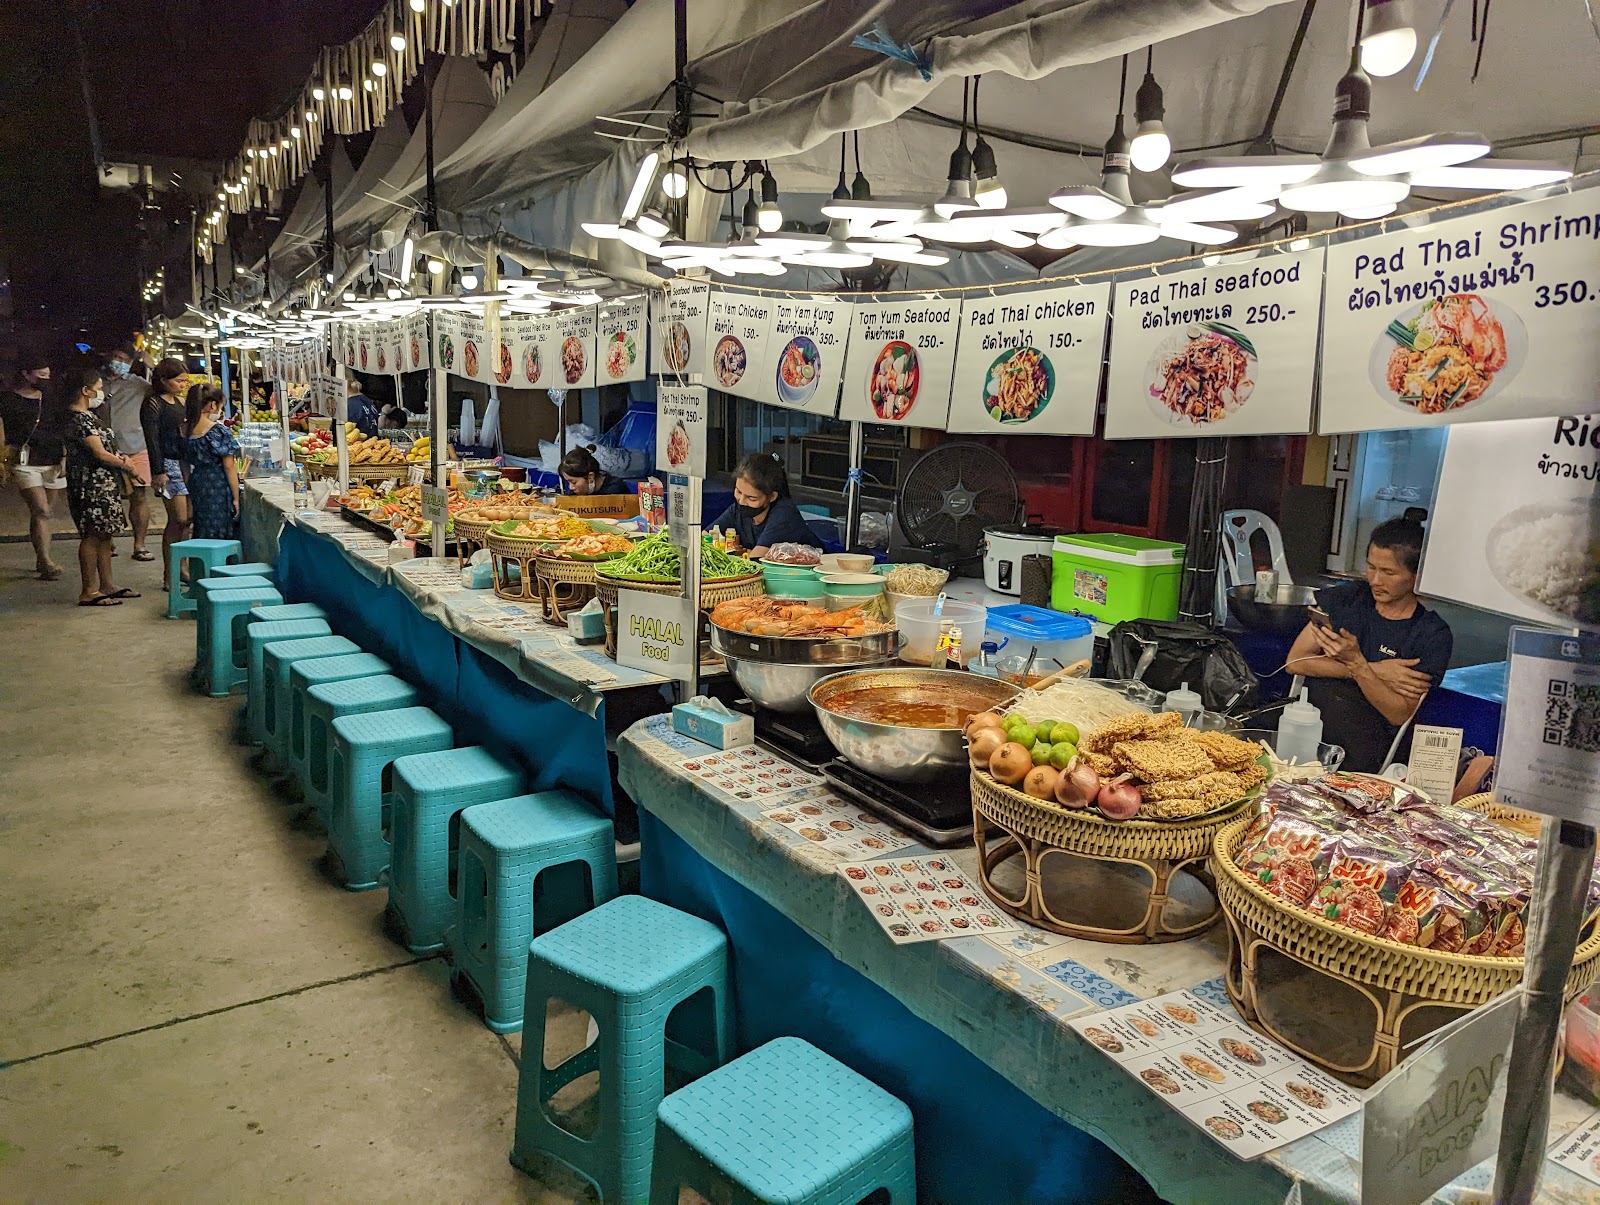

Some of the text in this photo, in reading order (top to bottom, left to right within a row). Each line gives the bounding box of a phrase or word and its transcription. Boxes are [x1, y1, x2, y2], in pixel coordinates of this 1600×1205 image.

[1355, 214, 1600, 279] Pad Thai Shrim
[672, 285, 690, 296] Seafood
[1130, 261, 1300, 307] Pad Thai seafood
[1348, 252, 1535, 312] ผัดไทยกุ้งแม่น้ำ
[712, 301, 722, 312] Tom
[738, 304, 768, 321] Chicken
[777, 305, 834, 325] Tom Yam Kung
[859, 307, 951, 325] Tom Yum Seafood
[971, 299, 1095, 327] Pad Thai chicken
[1142, 303, 1296, 329] ผัดไทยทะเล 250.-
[743, 327, 760, 340] 150.-
[819, 332, 839, 345] 350.-
[864, 328, 945, 349] ต้มยำทะเล 250.-
[981, 329, 1083, 350] ผัดไทยไก่ 150.-
[680, 393, 700, 406] Shrimp
[685, 410, 703, 423] 250.-
[630, 614, 684, 646] HALAL
[641, 641, 670, 662] Food
[1180, 992, 1233, 1023] Thai Papaya Salad
[1107, 1016, 1150, 1048] Papaya Salad with
[1113, 1026, 1133, 1041] Seafood
[1234, 1024, 1253, 1037] Papaya
[1255, 1036, 1269, 1046] Salad
[1269, 1045, 1282, 1054] with
[1162, 1056, 1209, 1090] Papaya Salad with
[1169, 1067, 1188, 1082] Shrimp
[1301, 1064, 1320, 1077] Papaya
[1320, 1076, 1336, 1086] Salad
[1336, 1085, 1349, 1094] with
[1259, 1080, 1327, 1125] Seafood Mama Salad
[1220, 1099, 1278, 1140] Seafood Salad
[1246, 1129, 1265, 1143] 300.-
